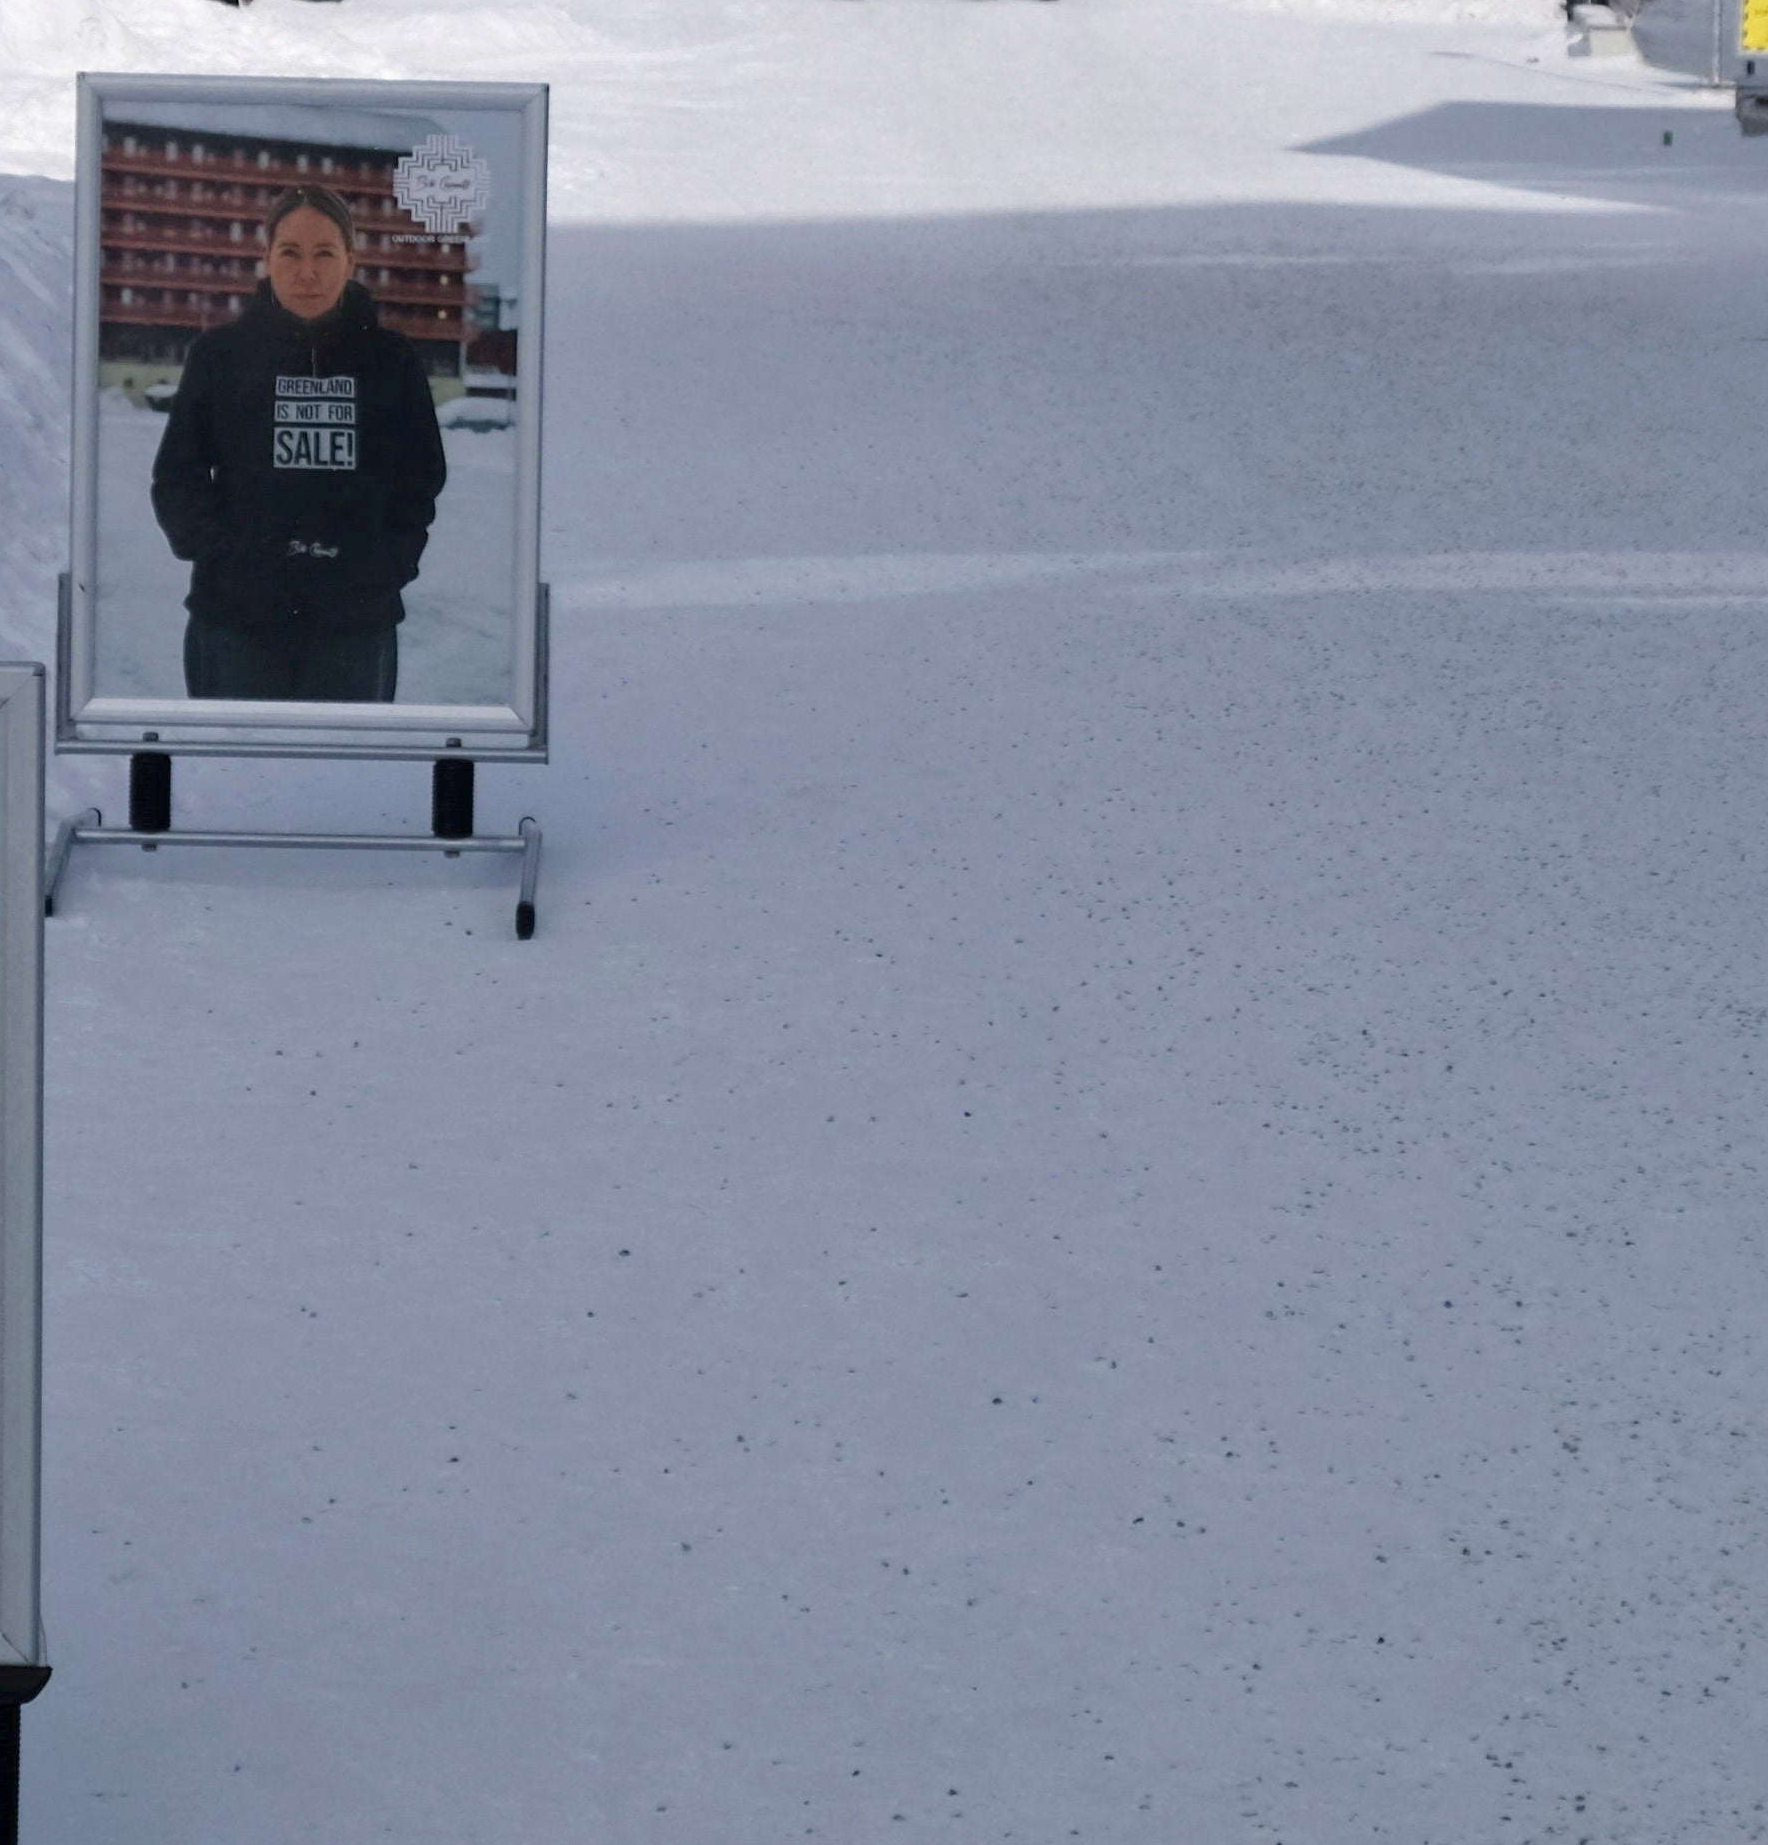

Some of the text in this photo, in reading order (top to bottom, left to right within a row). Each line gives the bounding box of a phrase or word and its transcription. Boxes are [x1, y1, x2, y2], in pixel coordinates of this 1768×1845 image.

[391, 235, 435, 244] OUTDOOR
[277, 378, 352, 395] GREENLAND
[276, 403, 353, 422] IS NOT FOR
[276, 430, 353, 467] SALE!
